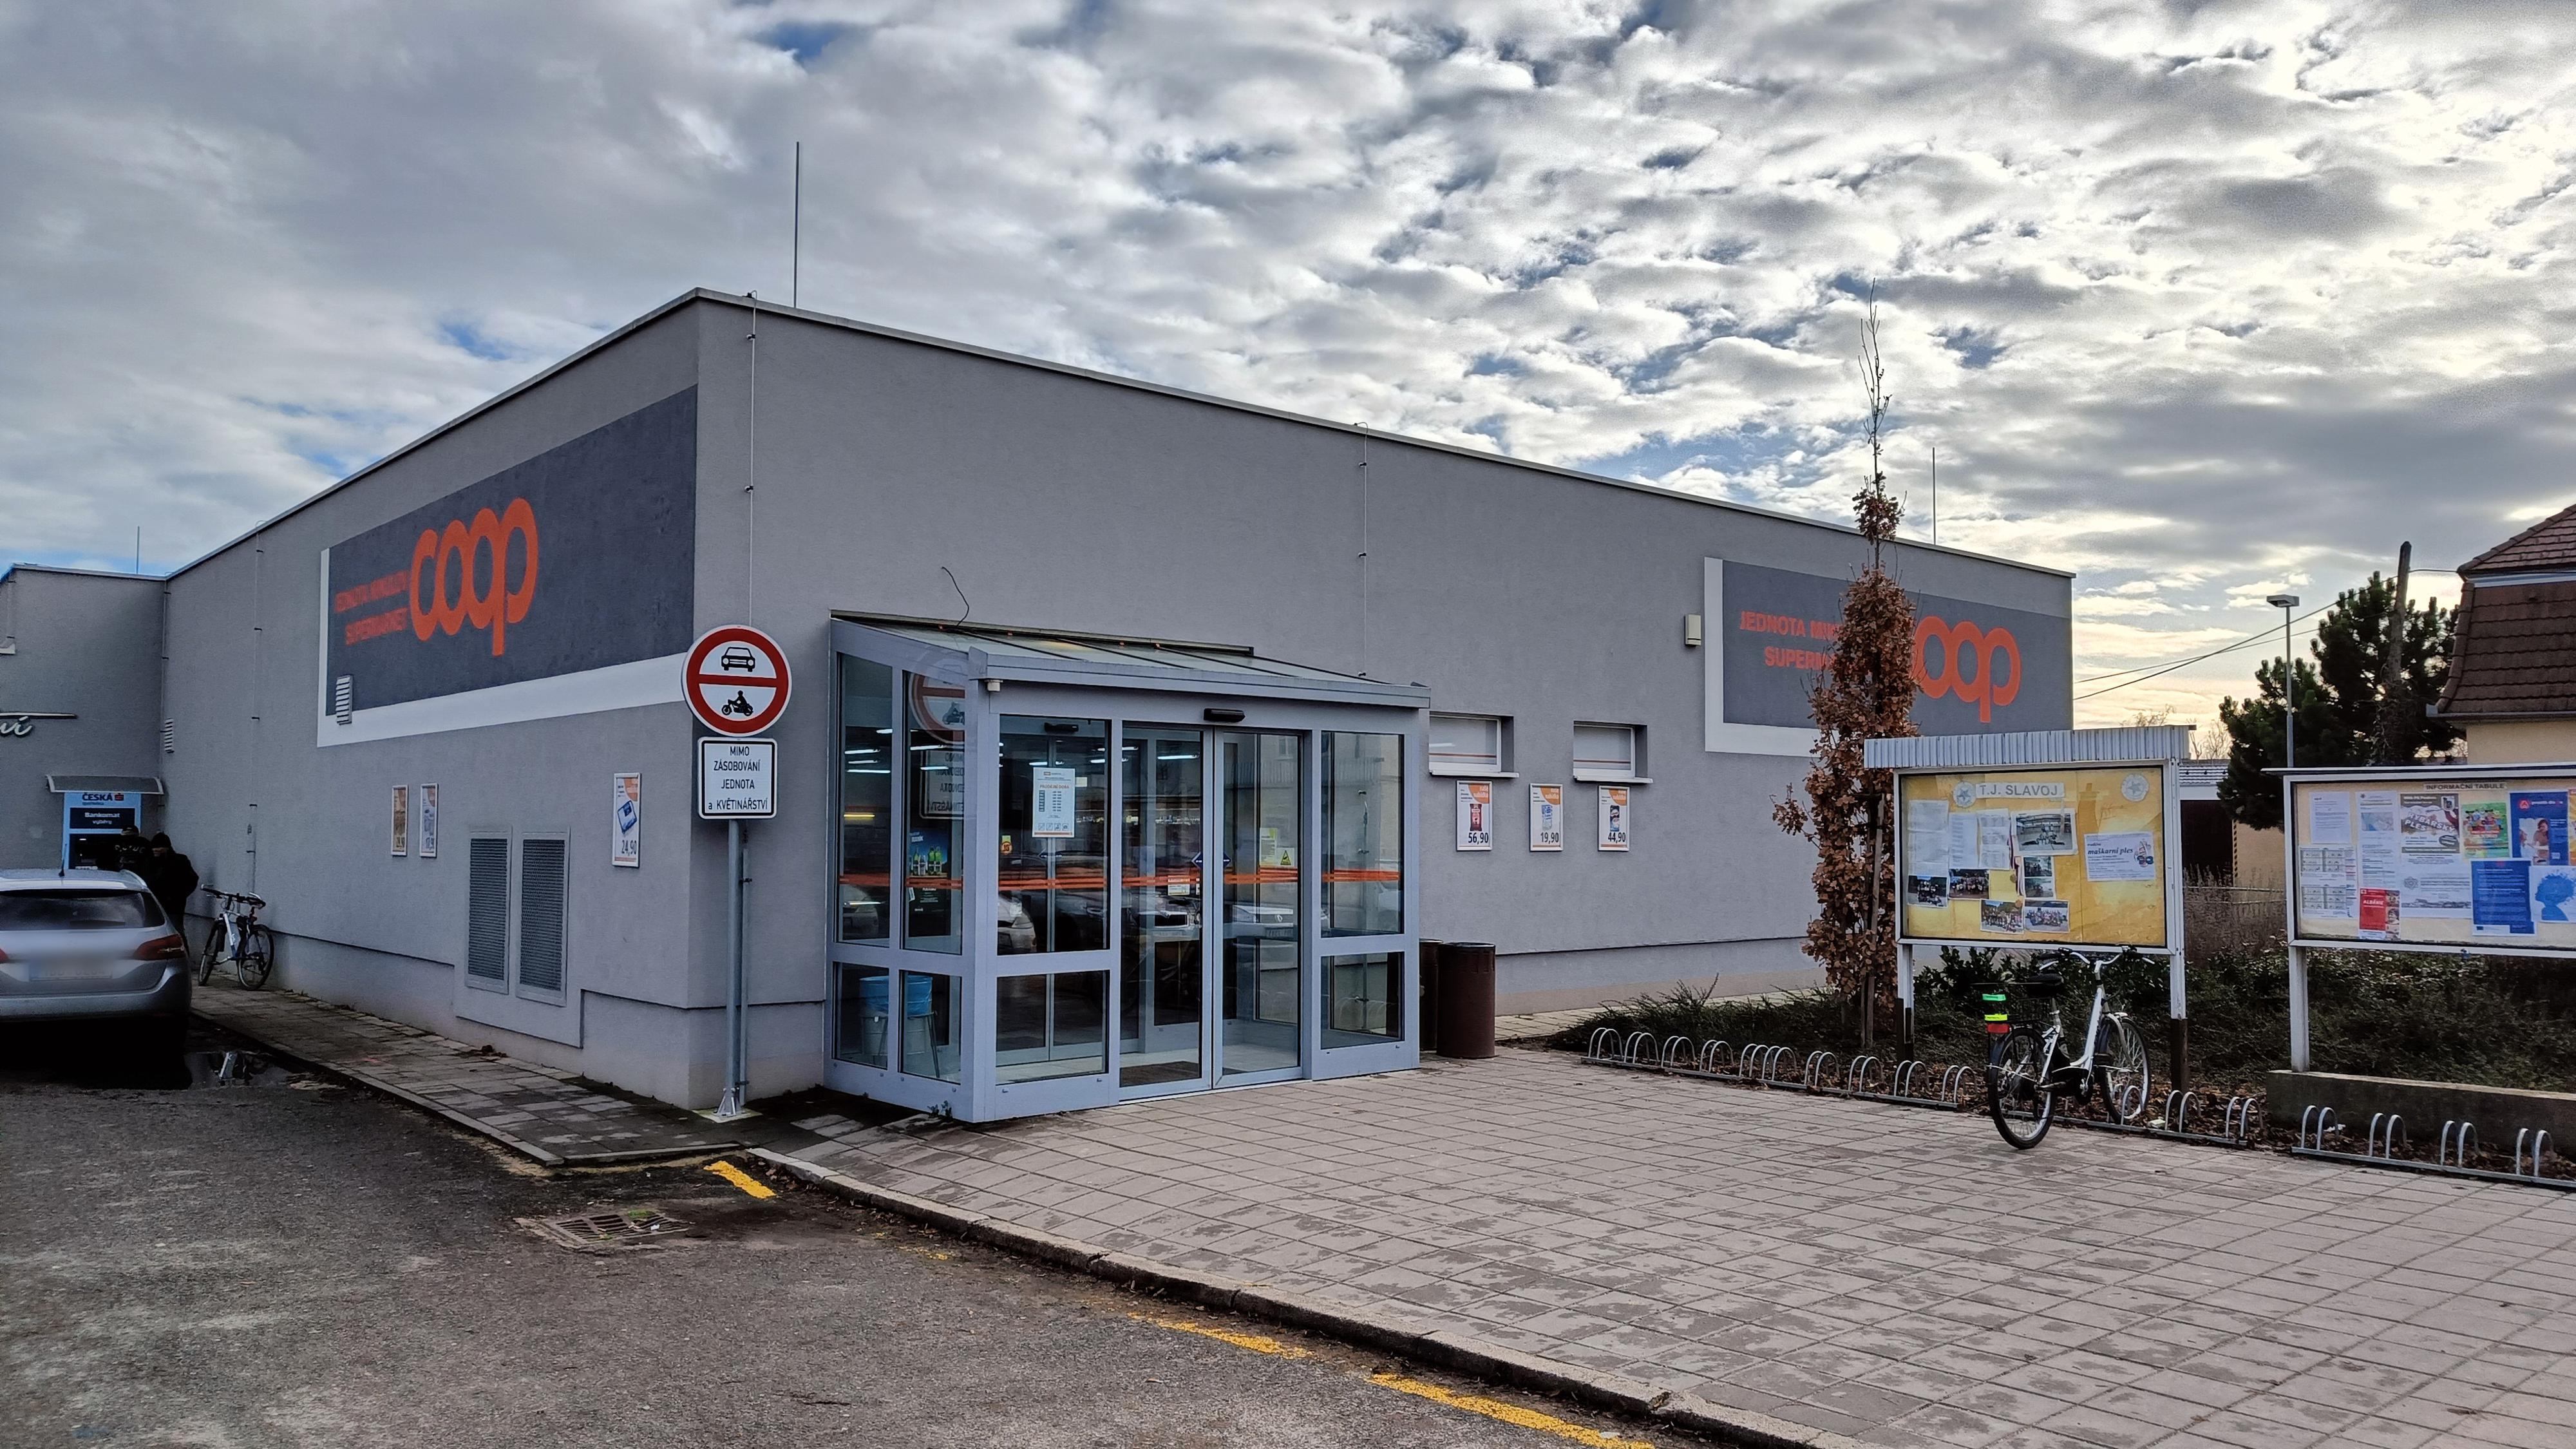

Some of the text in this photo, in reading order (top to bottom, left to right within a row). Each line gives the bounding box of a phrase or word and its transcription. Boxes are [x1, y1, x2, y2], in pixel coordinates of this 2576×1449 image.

[409, 496, 539, 657] coop
[1739, 610, 1806, 638] JEDNOTA
[1910, 615, 2022, 723] oop
[730, 746, 750, 756] MIMO
[714, 759, 761, 772] ZÁSOBOVÁNÍ
[721, 779, 755, 789] JEDNOTA
[1979, 784, 2058, 796] T.J. SLAVOJ
[82, 792, 113, 801] ČESKÁ
[716, 797, 768, 810] KVĚTINÁŘSTVÍ
[2404, 819, 2427, 831] PLES
[1468, 832, 1489, 845] 56,90
[1540, 832, 1559, 844] 19,90
[1608, 832, 1626, 844] 44,90
[621, 839, 637, 856] 24,90
[2119, 847, 2134, 855] ples
